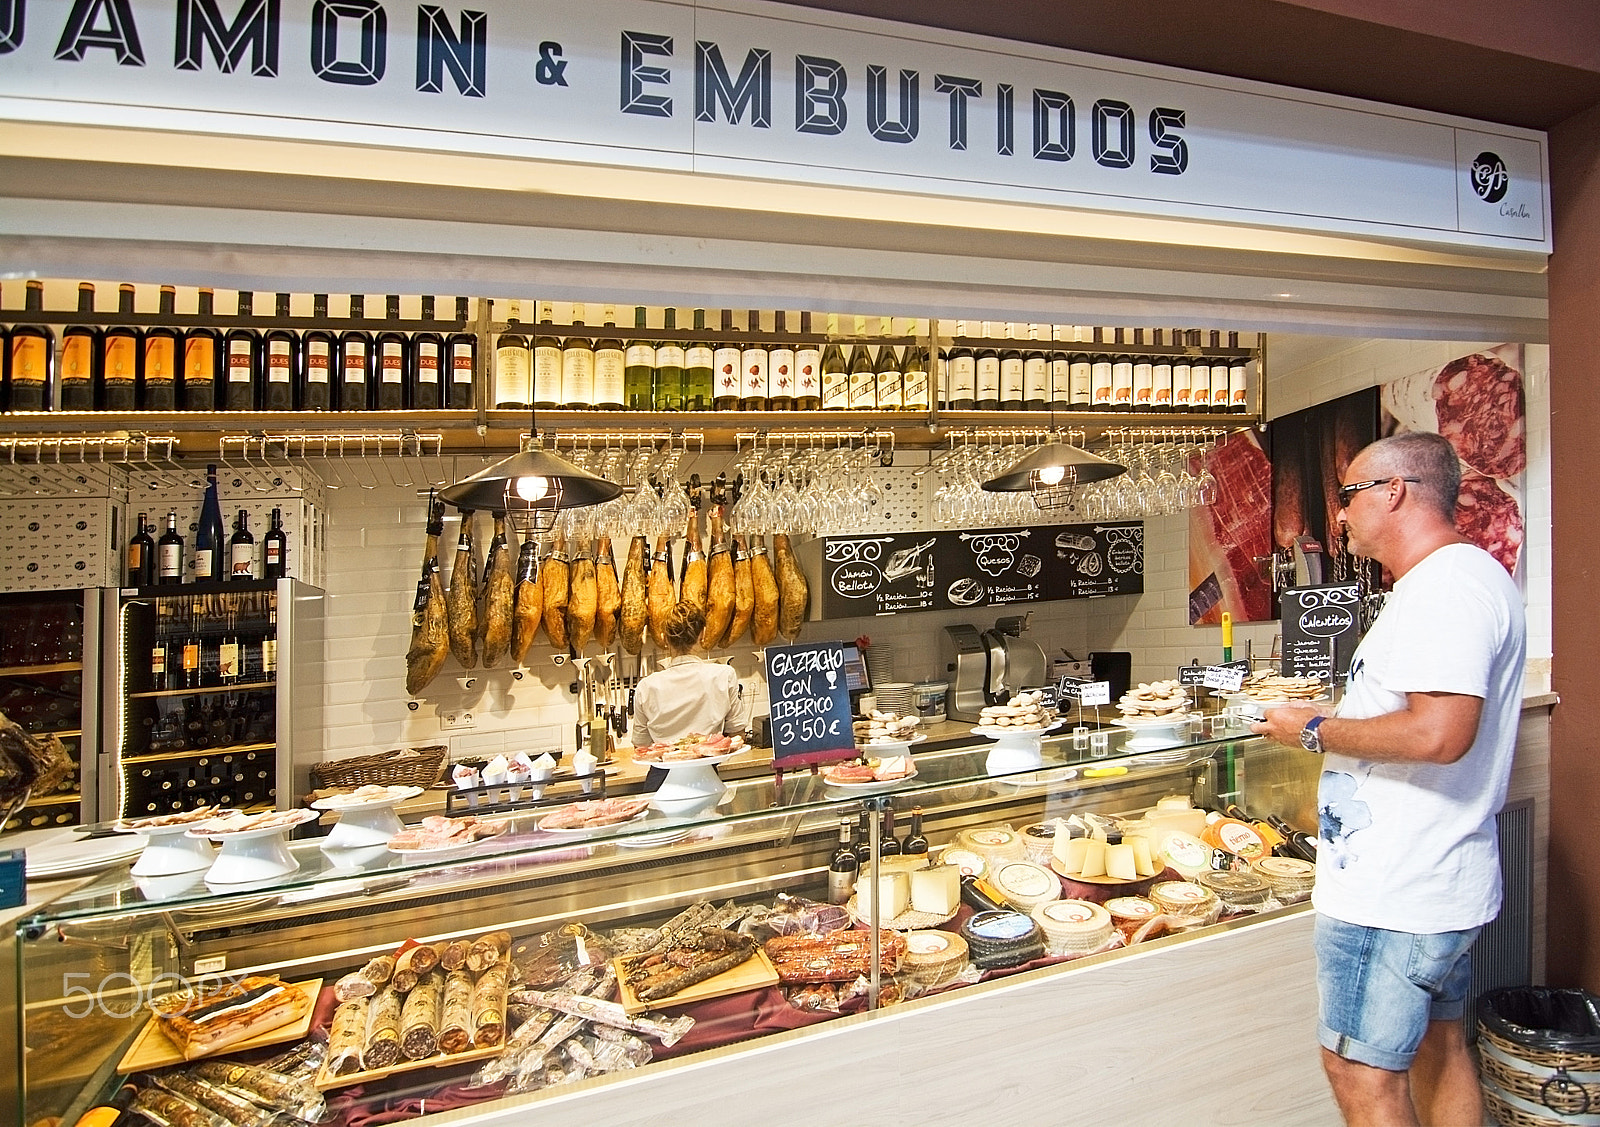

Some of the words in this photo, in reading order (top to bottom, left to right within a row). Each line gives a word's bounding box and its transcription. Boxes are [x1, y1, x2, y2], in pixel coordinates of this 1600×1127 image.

[534, 41, 569, 88] &
[620, 30, 1189, 176] EMBUTIDOS
[980, 556, 1011, 567] Quesos
[838, 580, 875, 591] Bellota
[1301, 614, 1351, 628] Calentitos
[771, 648, 844, 677] GAZPACHO
